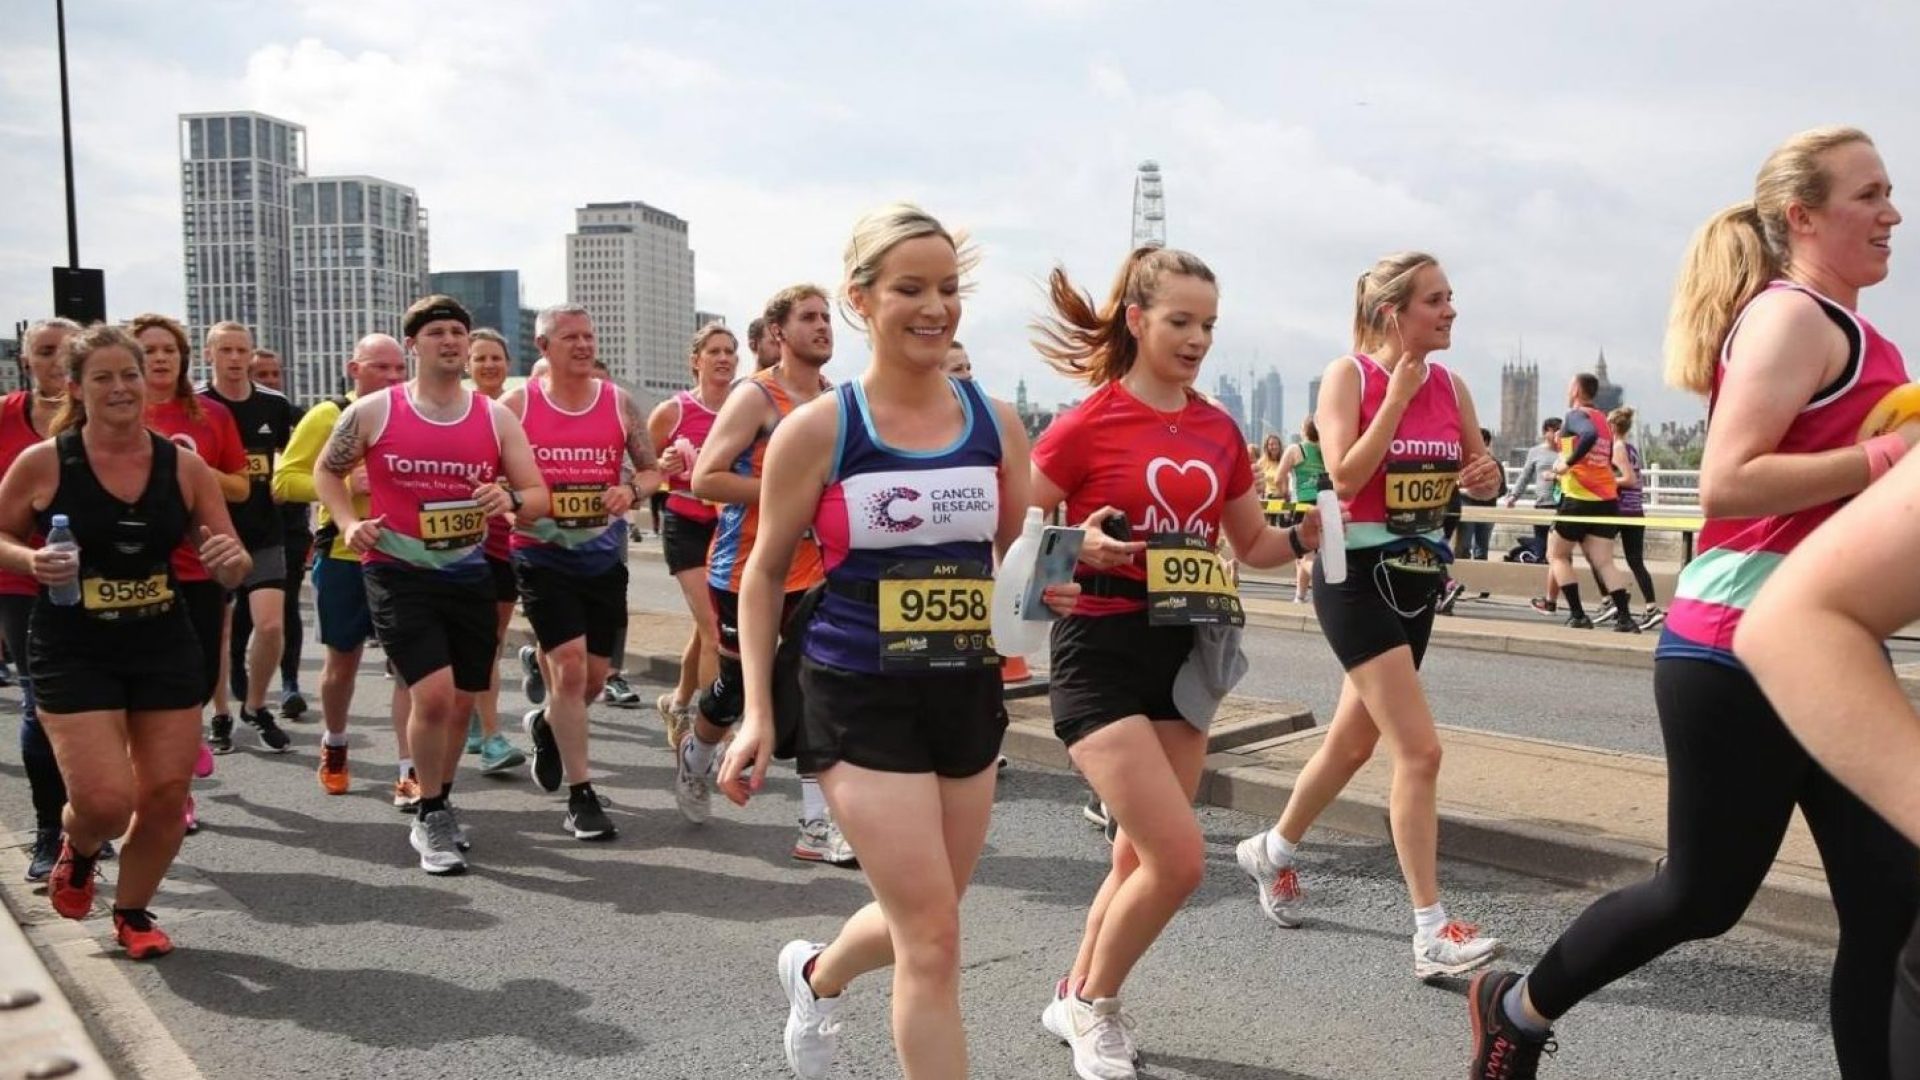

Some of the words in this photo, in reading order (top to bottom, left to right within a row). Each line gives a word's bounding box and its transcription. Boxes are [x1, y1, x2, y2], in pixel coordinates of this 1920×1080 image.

[529, 445, 616, 465] ommy's
[1390, 439, 1463, 461] ommy'
[383, 453, 494, 479] Tommy's
[931, 488, 984, 500] CANCER
[1393, 478, 1455, 503] 10627
[557, 496, 602, 512] 1016
[932, 499, 994, 513] RESEARCH
[426, 511, 485, 534] 11367
[932, 513, 952, 525] UK
[933, 564, 959, 575] AMY
[900, 588, 987, 623] 9558
